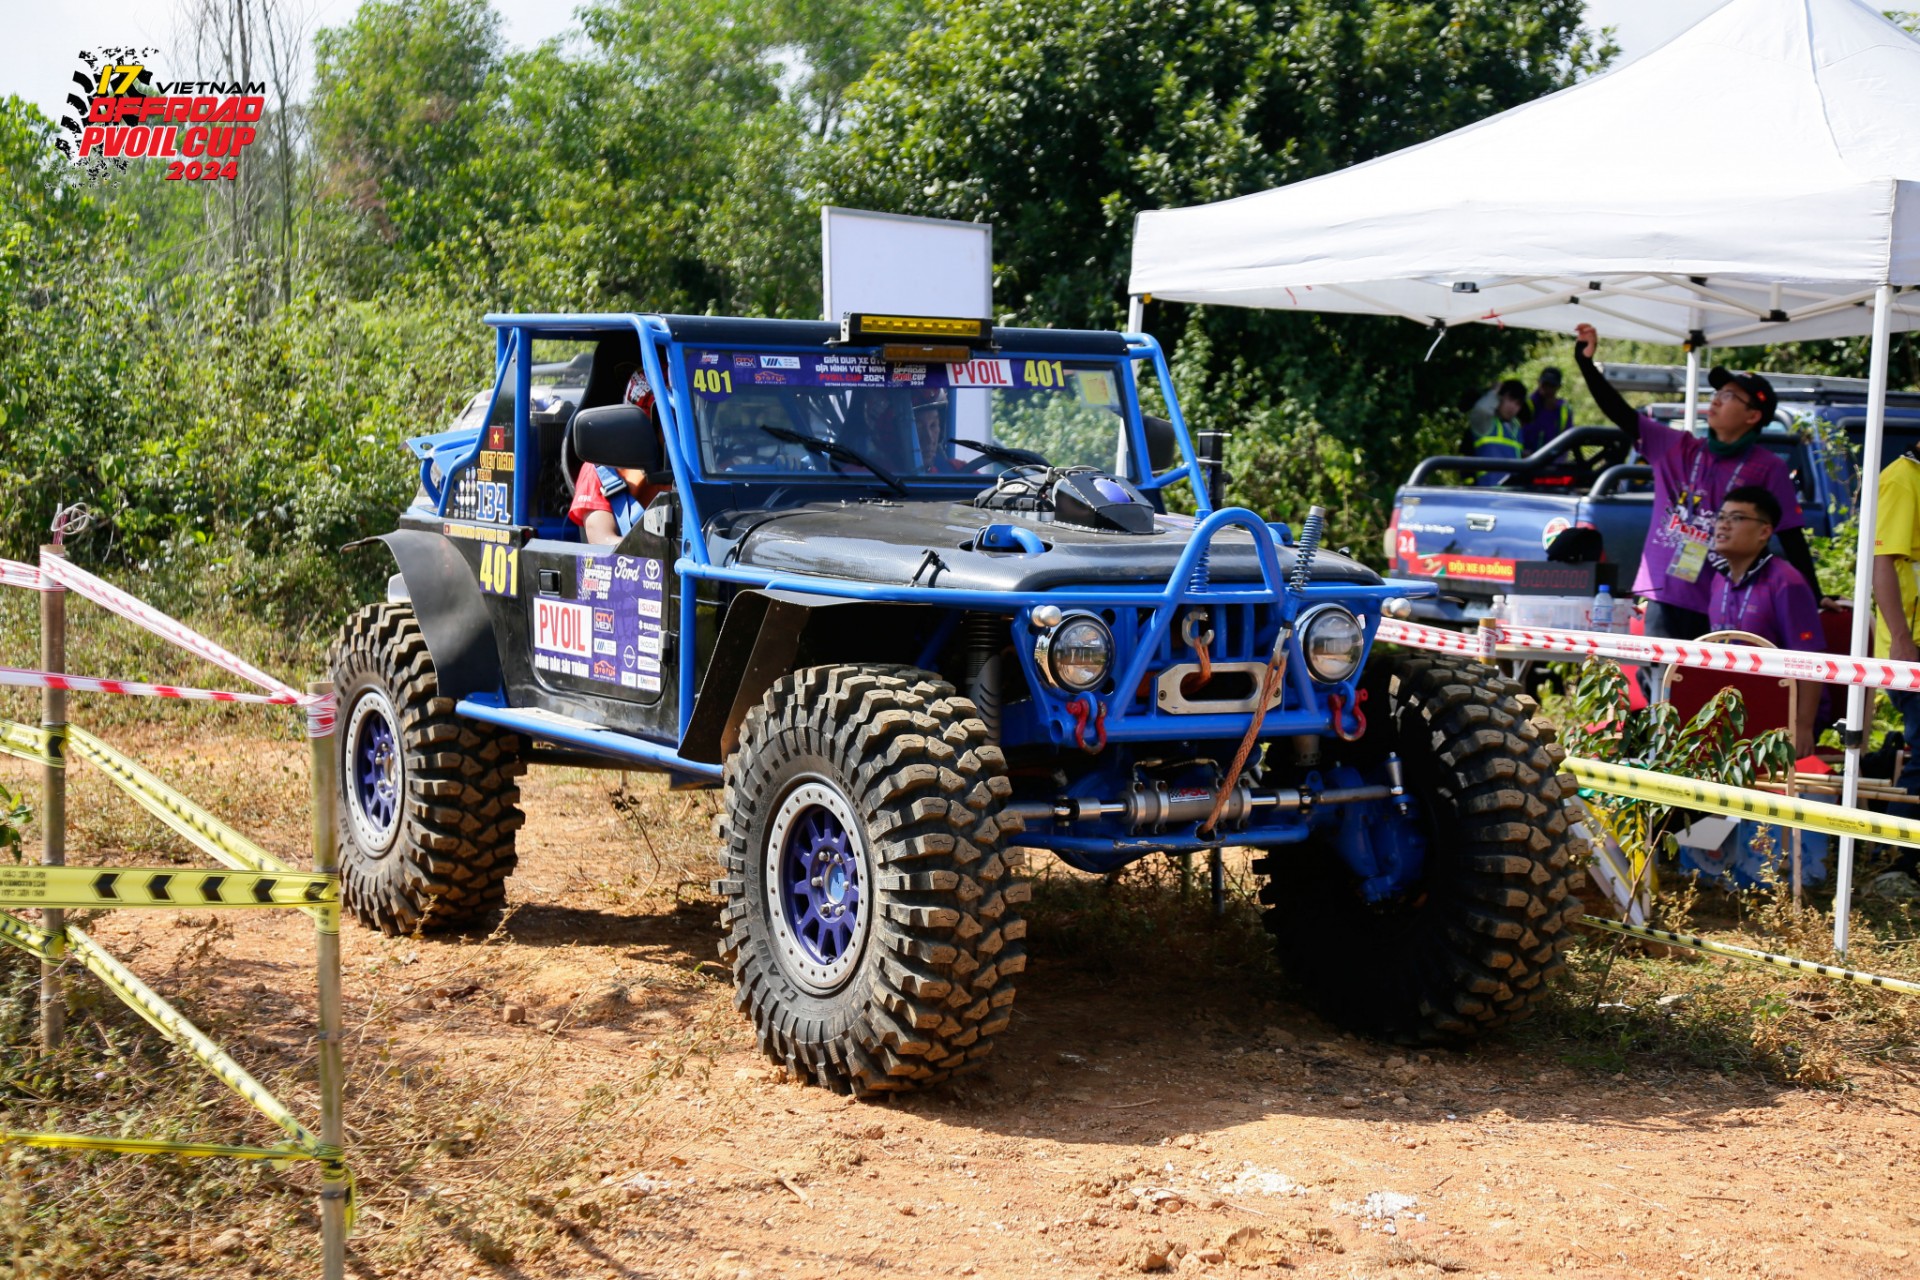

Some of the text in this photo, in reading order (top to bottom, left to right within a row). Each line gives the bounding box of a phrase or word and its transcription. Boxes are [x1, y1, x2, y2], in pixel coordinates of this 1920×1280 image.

[693, 369, 732, 394] 401
[864, 374, 885, 382] 2024
[951, 360, 1007, 385] PVOIL
[1024, 359, 1065, 388] 401
[1398, 536, 1416, 553] 24
[480, 543, 518, 596] 401
[614, 556, 640, 582] Ford
[598, 580, 611, 592] CUP
[642, 580, 662, 591] TOYOTA
[540, 603, 586, 652] PVOIL
[756, 938, 799, 1003] CLAW
